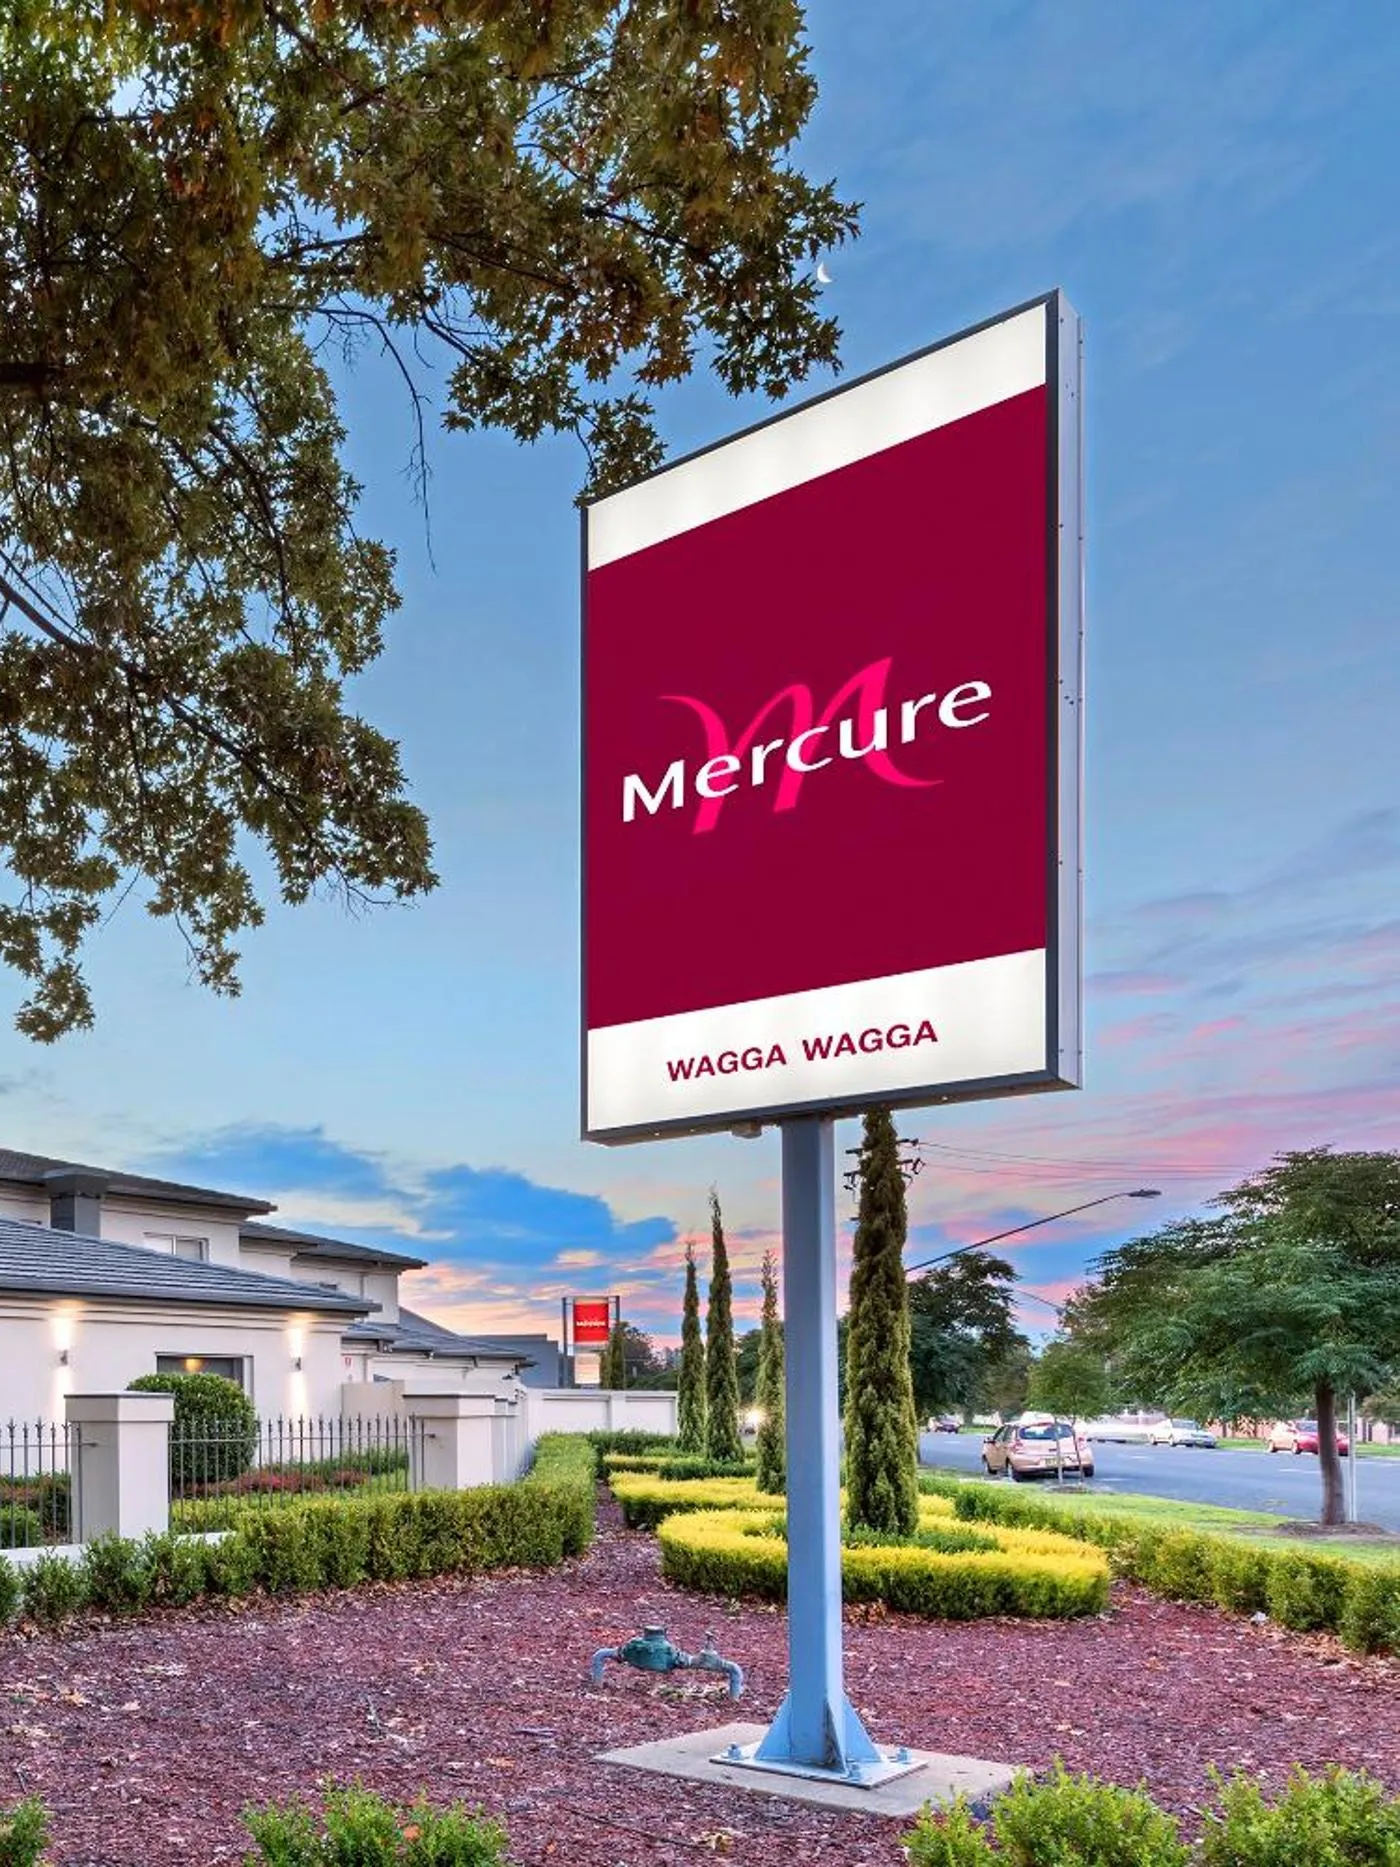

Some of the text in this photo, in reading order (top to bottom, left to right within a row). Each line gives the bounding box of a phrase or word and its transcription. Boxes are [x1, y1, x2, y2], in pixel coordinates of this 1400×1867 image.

[622, 679, 992, 823] Mercure
[666, 1020, 939, 1082] WAGGA WAGGA
